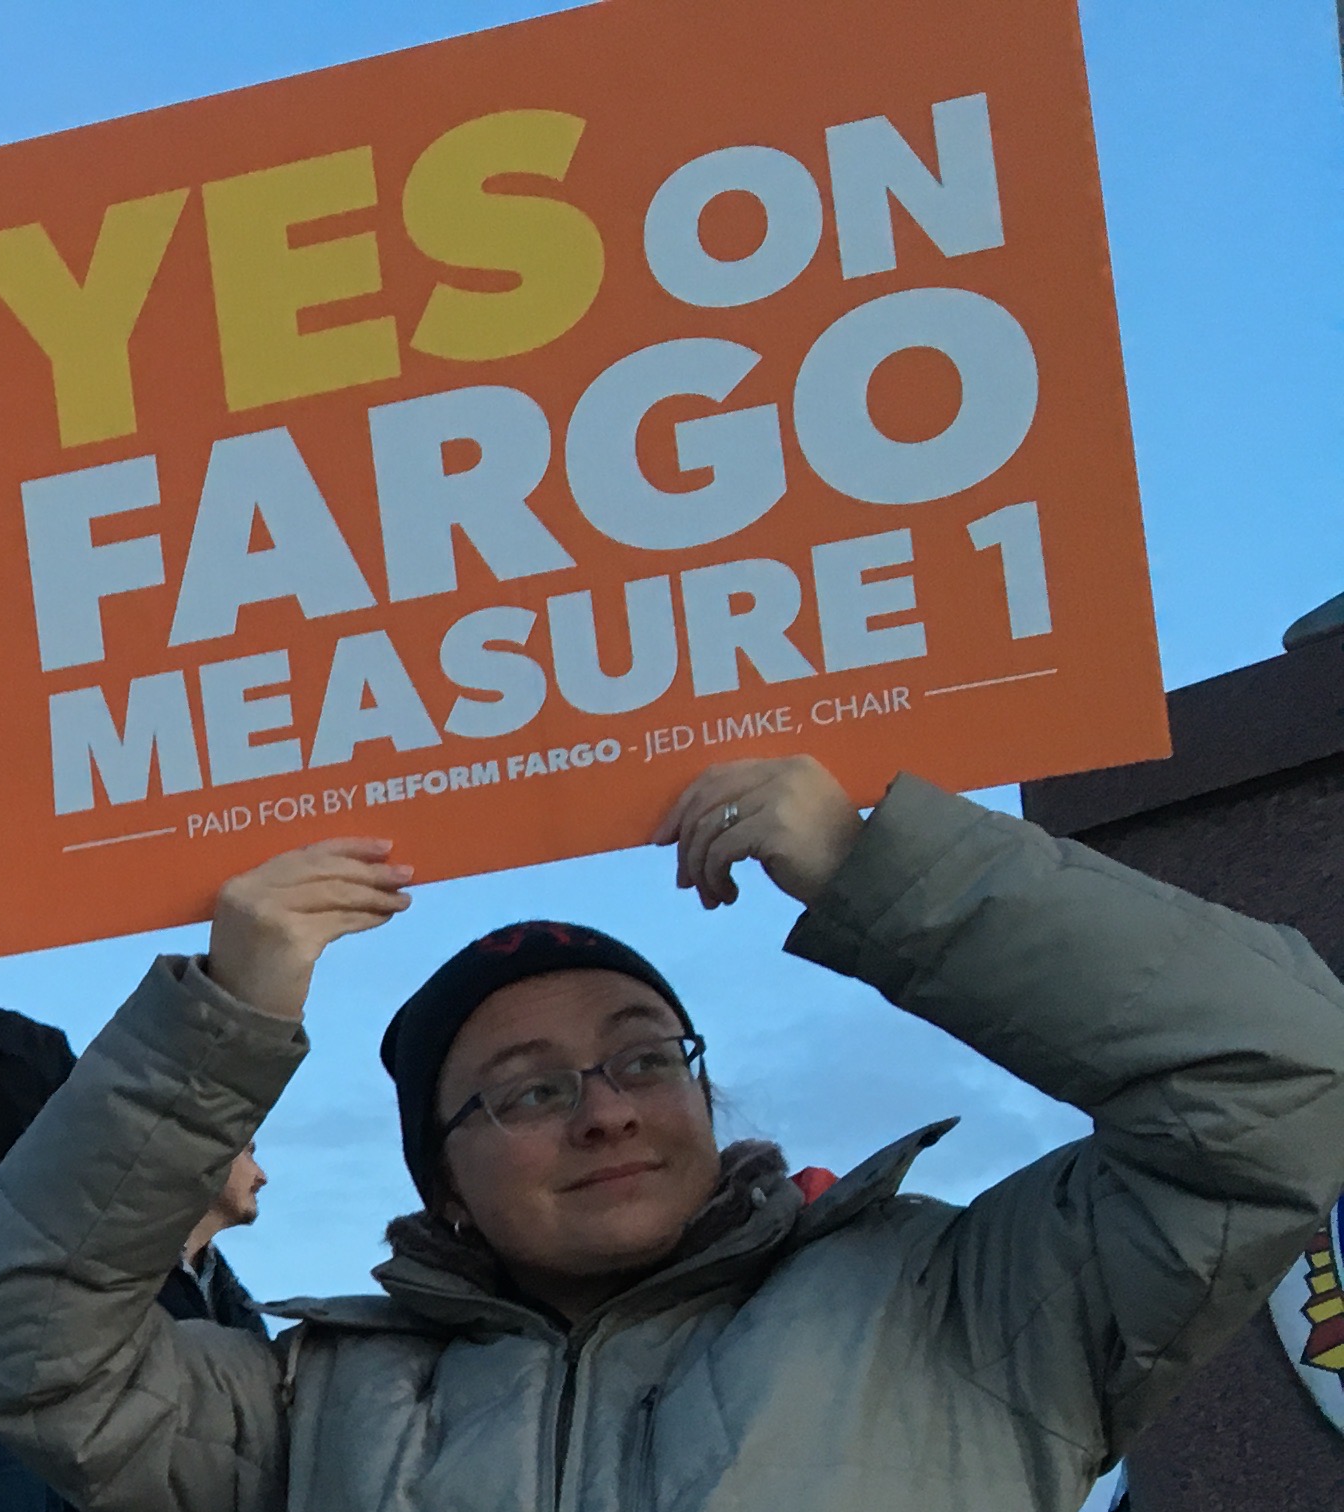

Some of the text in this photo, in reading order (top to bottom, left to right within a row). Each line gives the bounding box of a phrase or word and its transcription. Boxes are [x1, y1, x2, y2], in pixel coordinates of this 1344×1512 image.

[644, 92, 1005, 308] ON
[20, 287, 1039, 673] FARGO
[49, 501, 1052, 816] MEASURE 1
[187, 806, 251, 838] PAID
[259, 794, 317, 826] FOR
[323, 785, 358, 813] BY
[365, 760, 500, 806] REFORM
[508, 738, 622, 782] FARGO
[643, 725, 696, 762] JED
[703, 706, 803, 746] LIMKE,
[811, 686, 912, 726] CHAIR
